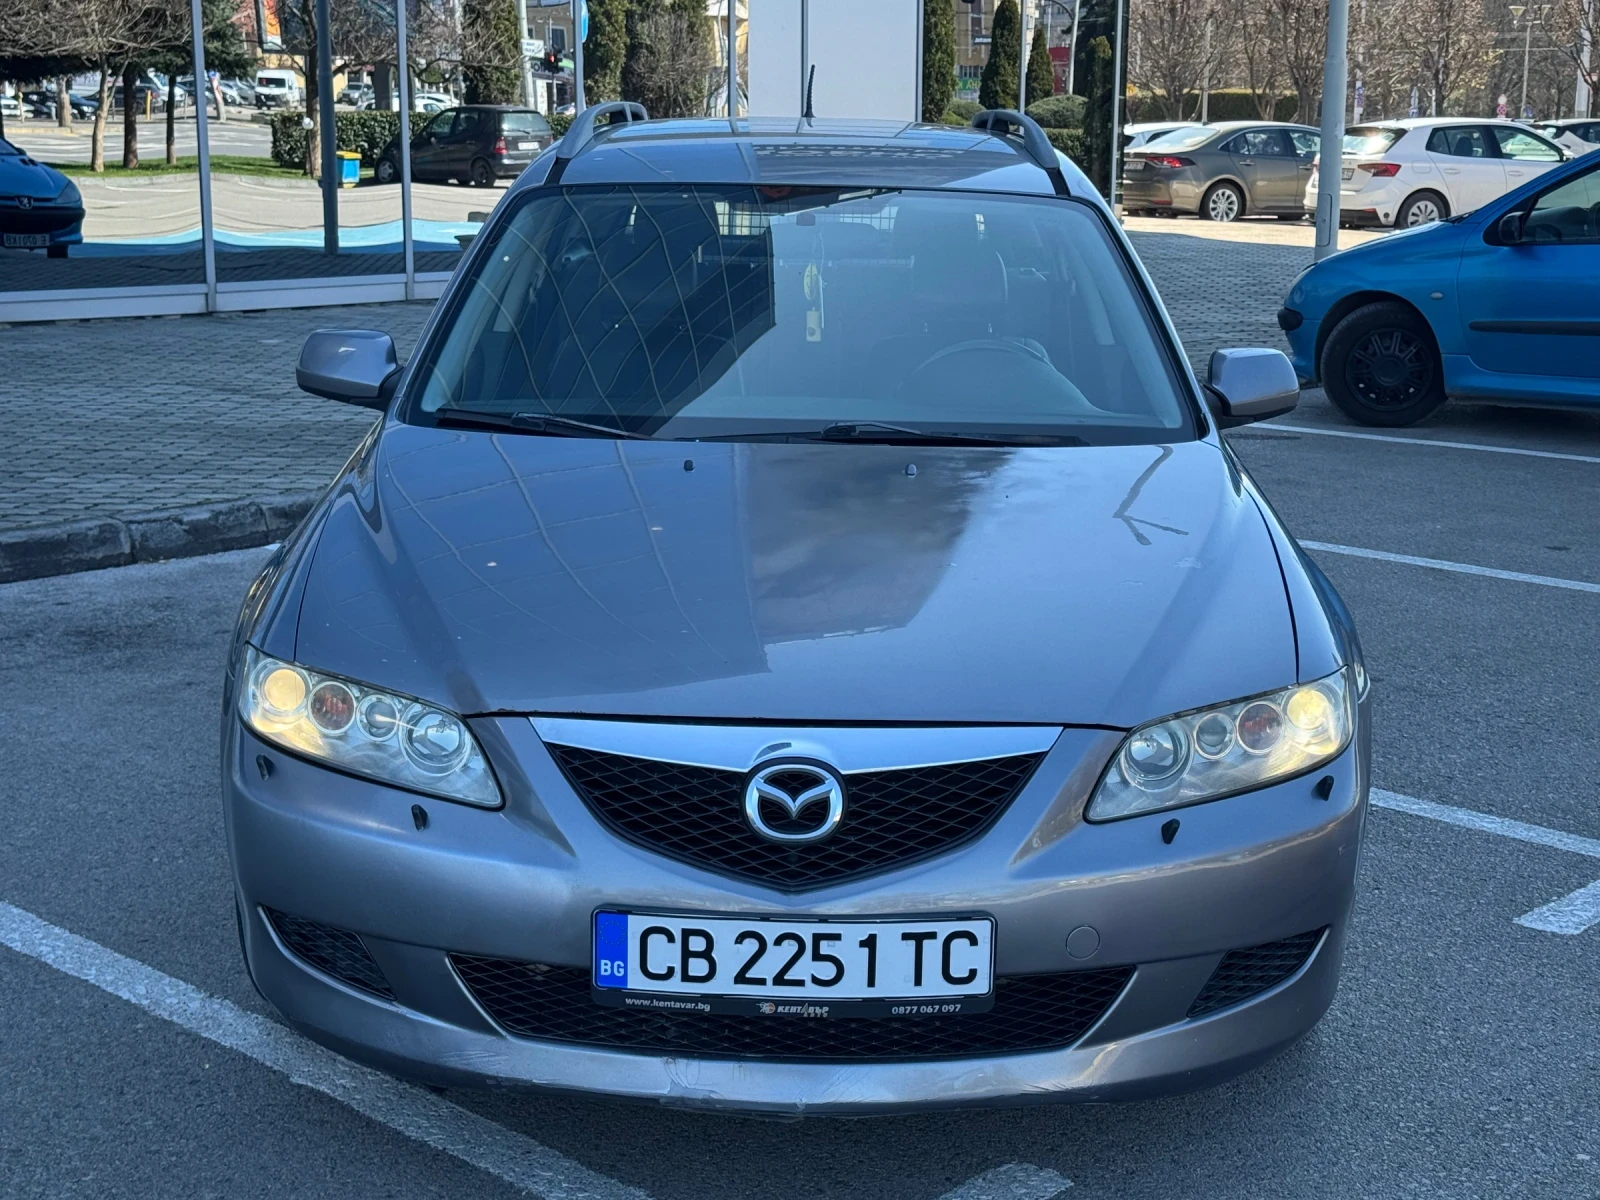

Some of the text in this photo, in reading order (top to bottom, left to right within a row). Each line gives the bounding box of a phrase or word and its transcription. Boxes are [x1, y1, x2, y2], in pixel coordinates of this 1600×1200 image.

[640, 926, 979, 988] CB 2251 TC
[600, 959, 625, 977] BG
[625, 997, 711, 1012] www.kentavar.bg
[891, 1003, 962, 1015] 0877 067 097
